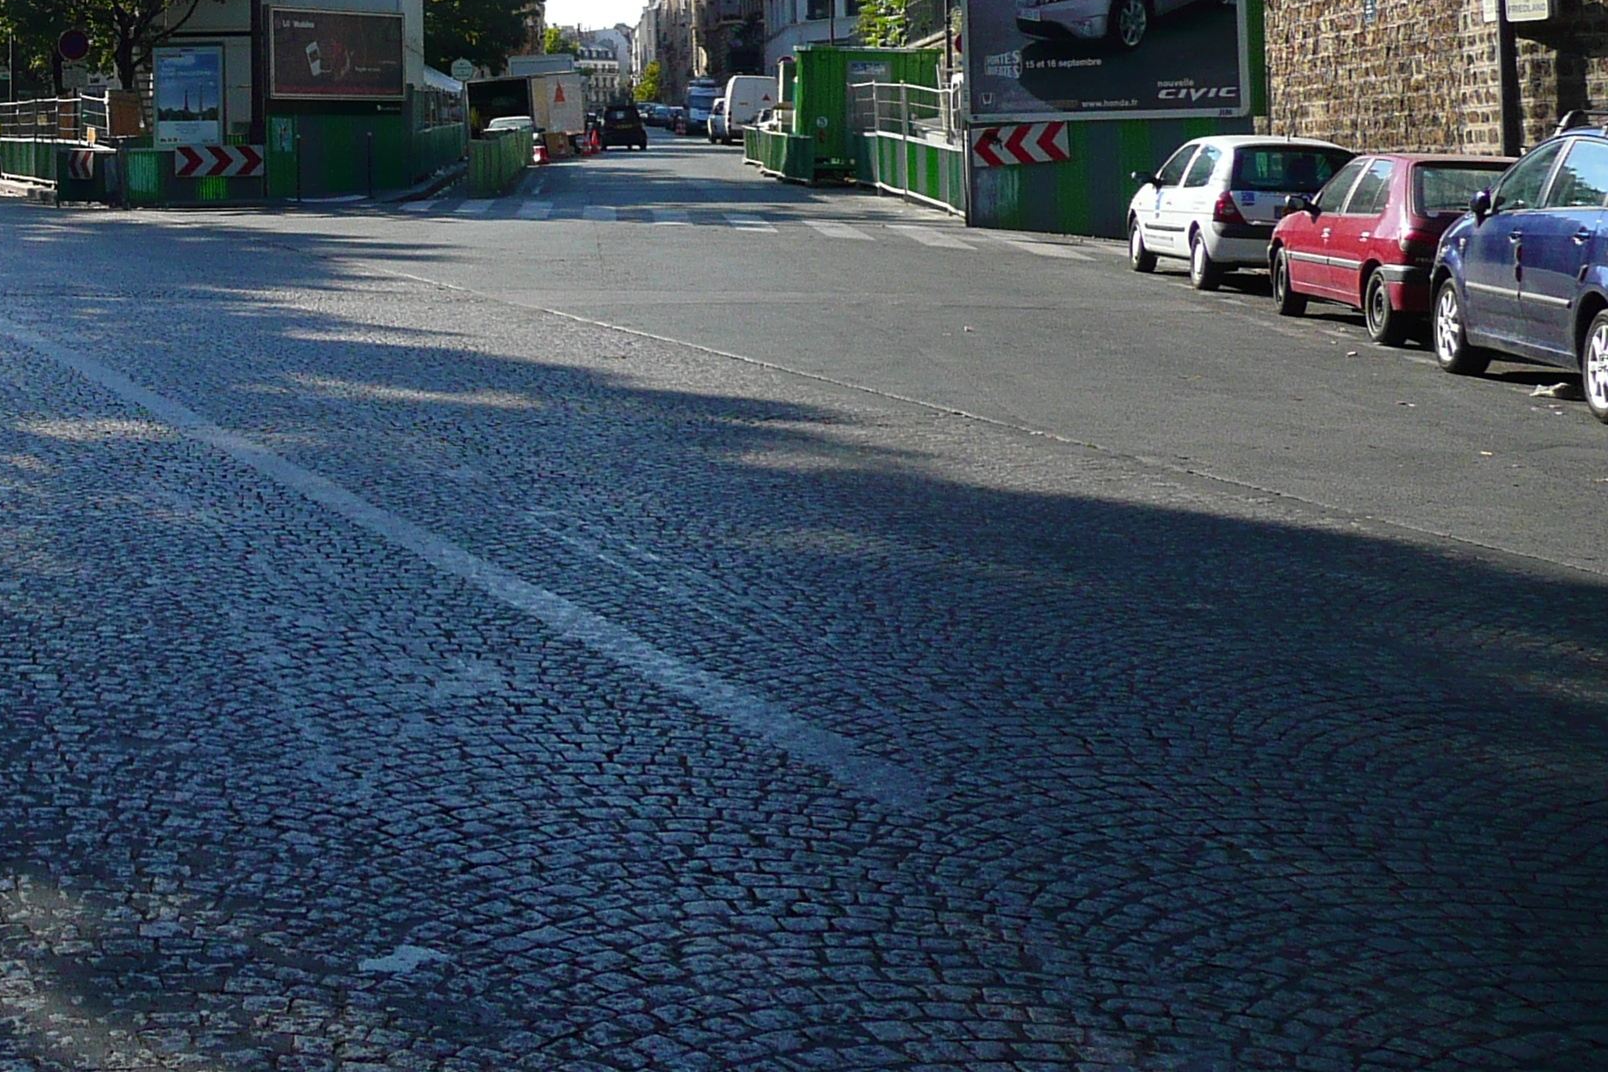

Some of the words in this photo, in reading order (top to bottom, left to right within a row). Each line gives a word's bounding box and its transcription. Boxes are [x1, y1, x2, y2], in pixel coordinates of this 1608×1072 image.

[1508, 3, 1546, 14] FRIEDLAND
[1057, 58, 1102, 68] septembre
[1157, 78, 1194, 87] nouvelle
[1082, 99, 1139, 108] www.honda.fr
